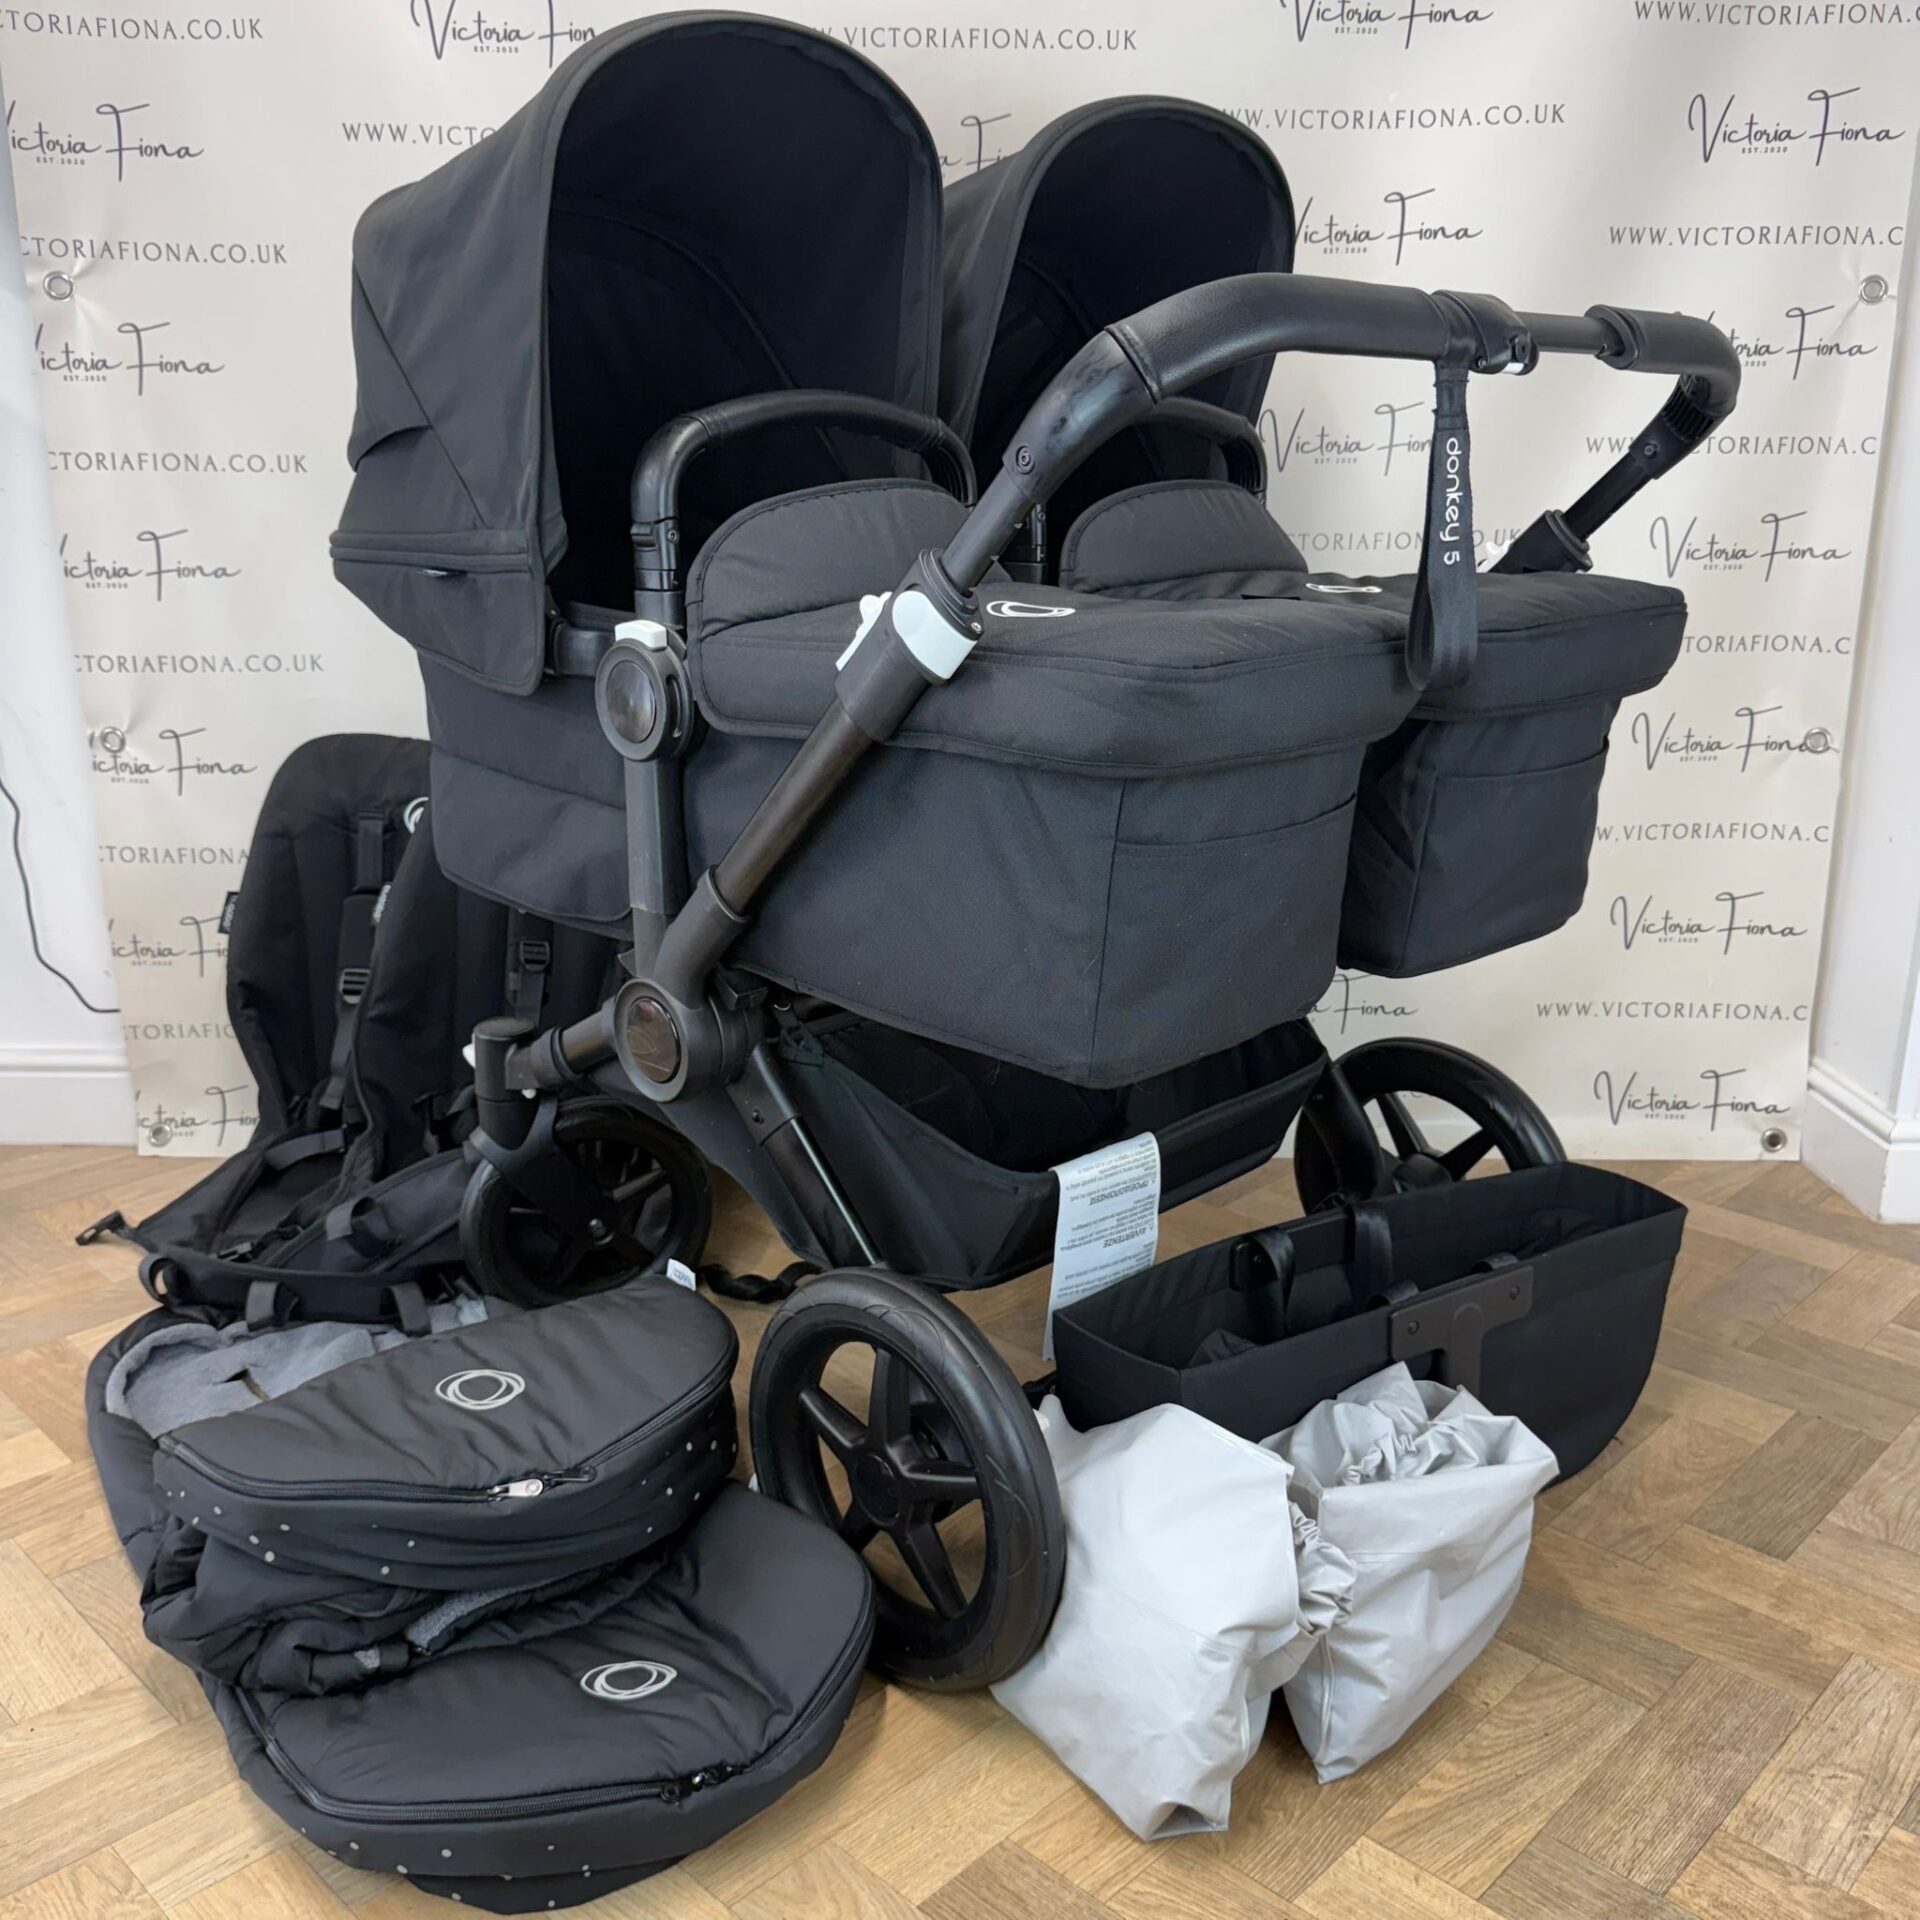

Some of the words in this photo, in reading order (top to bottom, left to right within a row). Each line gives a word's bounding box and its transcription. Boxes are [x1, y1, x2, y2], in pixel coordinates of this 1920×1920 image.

[812, 26, 1137, 50] VICTORIAFIONA.CO.UK
[1688, 93, 1807, 163] Victoria
[1807, 86, 1906, 166] Fiona
[1609, 225, 1903, 246] WWW.VICTORIAFIONA.C
[1439, 436, 1463, 544] donkey
[1443, 550, 1461, 566] 5
[89, 730, 164, 776] ictoria
[99, 845, 249, 865] TORIAFIONA
[108, 917, 188, 959] ictoria
[135, 1089, 207, 1131] ictoria
